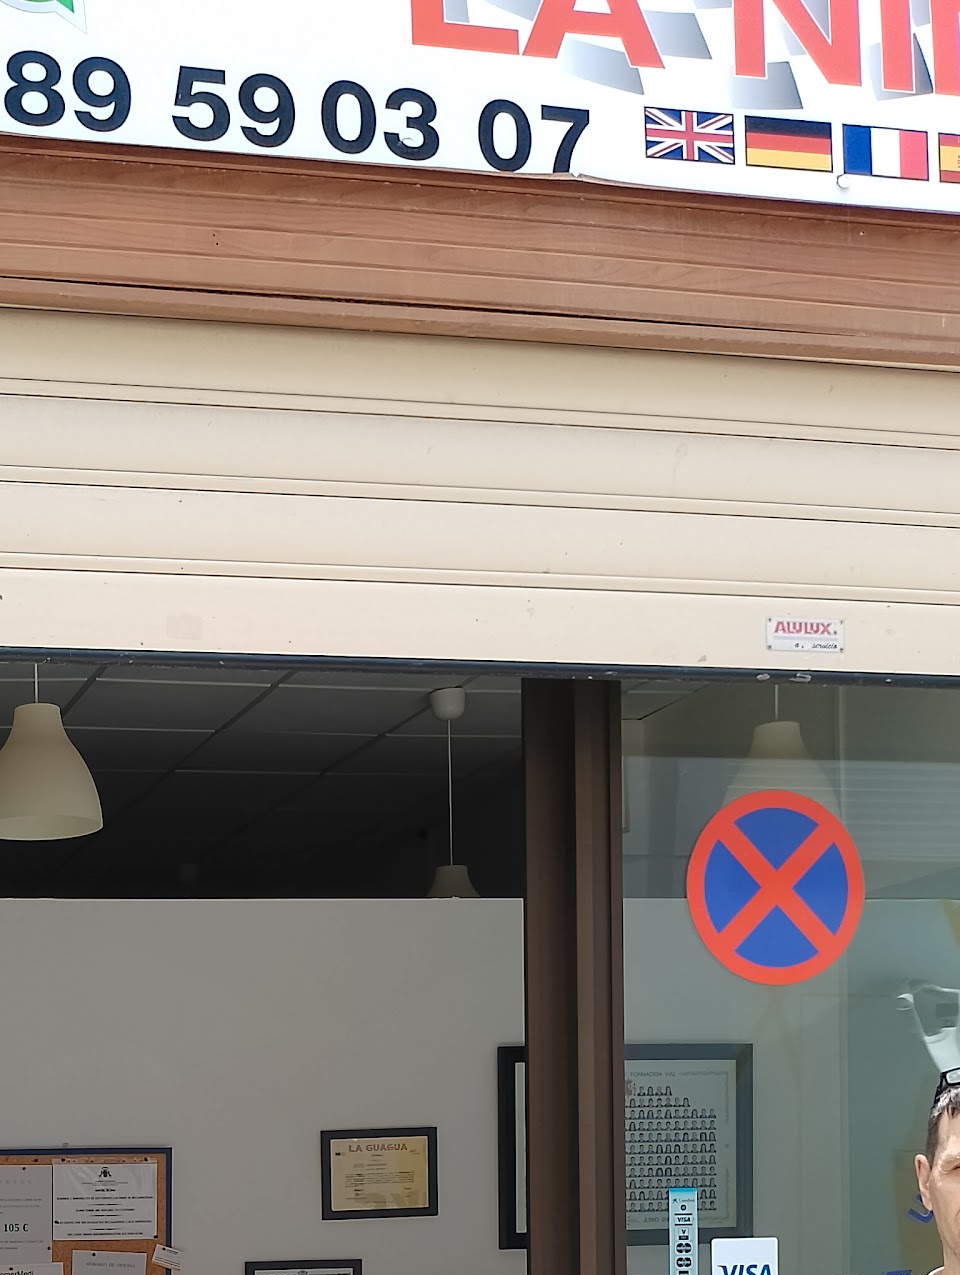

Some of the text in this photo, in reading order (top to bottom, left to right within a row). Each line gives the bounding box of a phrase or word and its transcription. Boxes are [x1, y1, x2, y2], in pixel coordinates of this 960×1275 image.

[171, 65, 295, 148] 59
[321, 79, 439, 161] 03
[478, 98, 589, 174] 07
[366, 1143, 407, 1151] GUAGUA
[4, 1223, 19, 1232] 105
